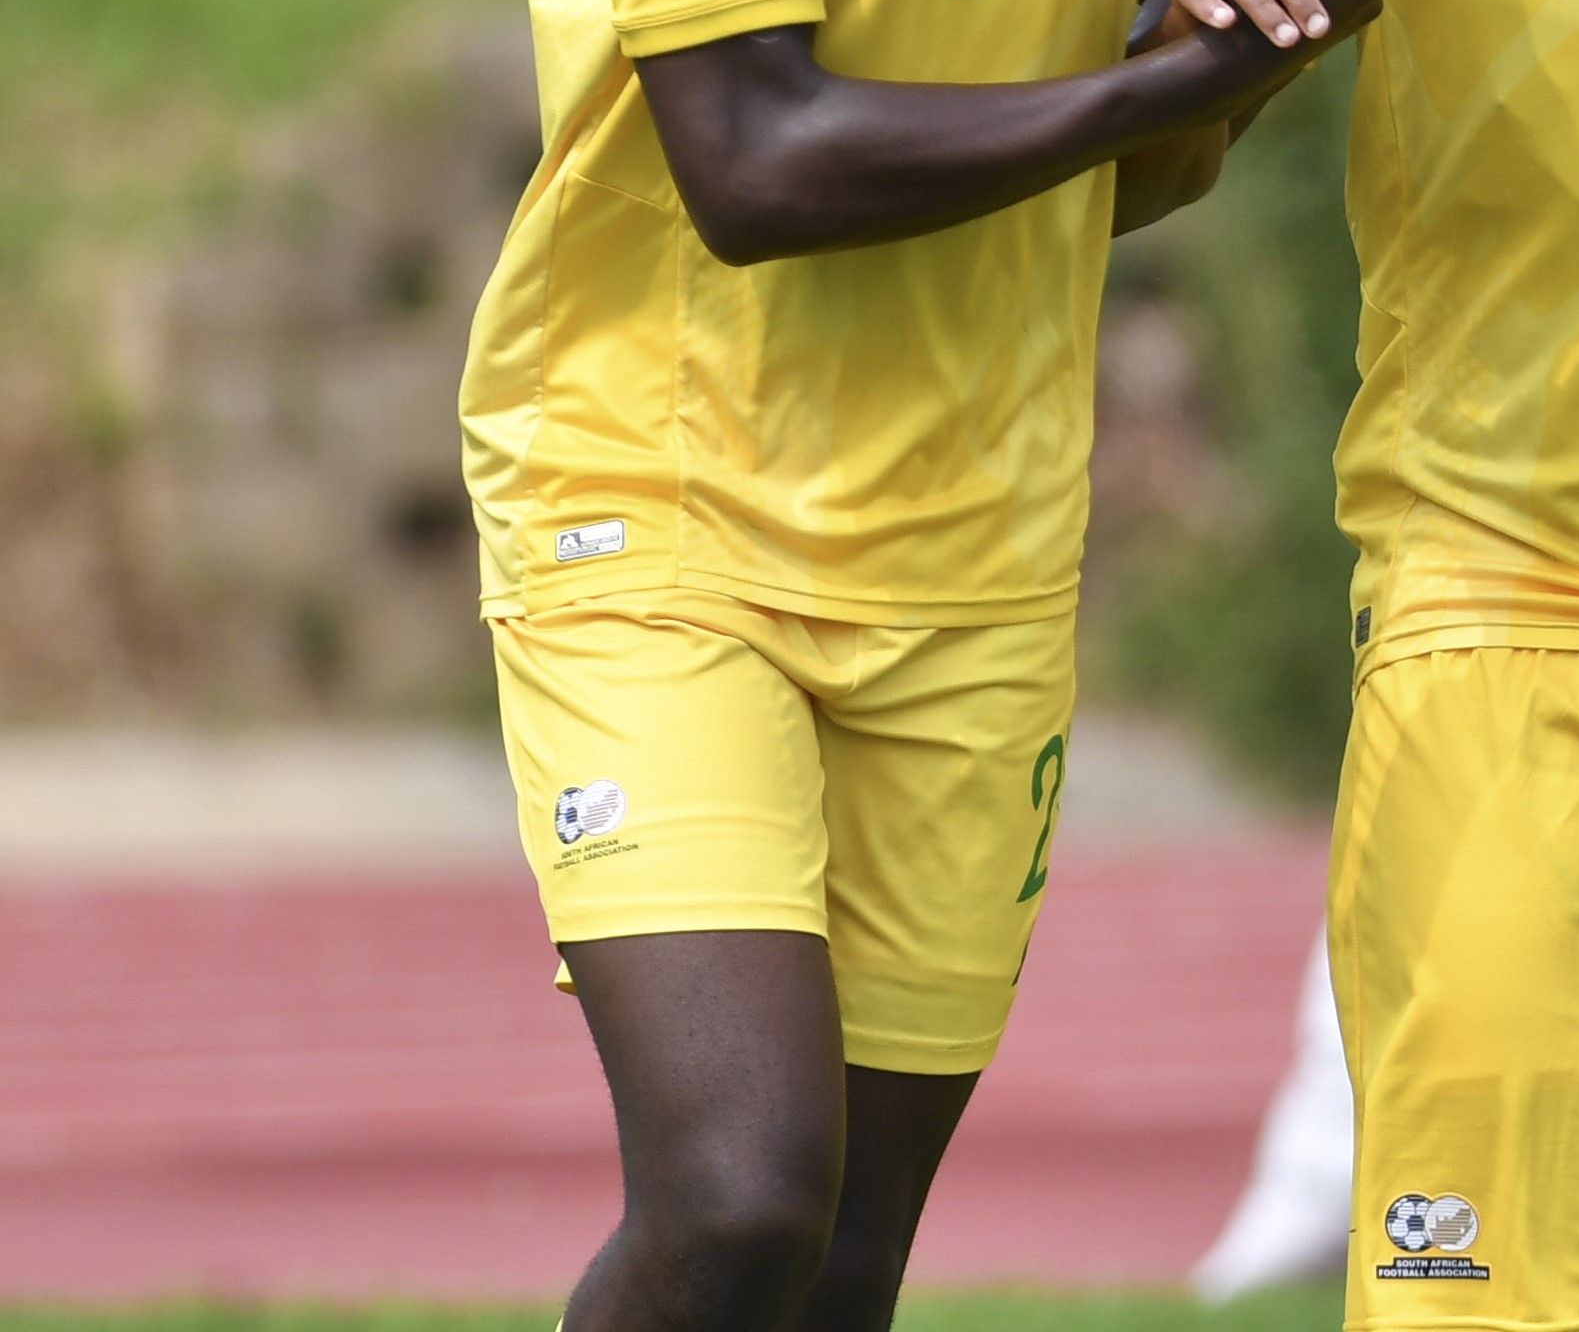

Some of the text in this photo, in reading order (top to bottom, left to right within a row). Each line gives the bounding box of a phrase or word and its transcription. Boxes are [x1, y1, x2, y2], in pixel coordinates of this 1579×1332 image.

[1017, 728, 1072, 904] 2
[583, 843, 639, 861] ASSOCIATION
[1396, 1259, 1470, 1268] SOUTH AFRICAN
[1378, 1268, 1488, 1278] FOOTBALL ASSOCIATION
